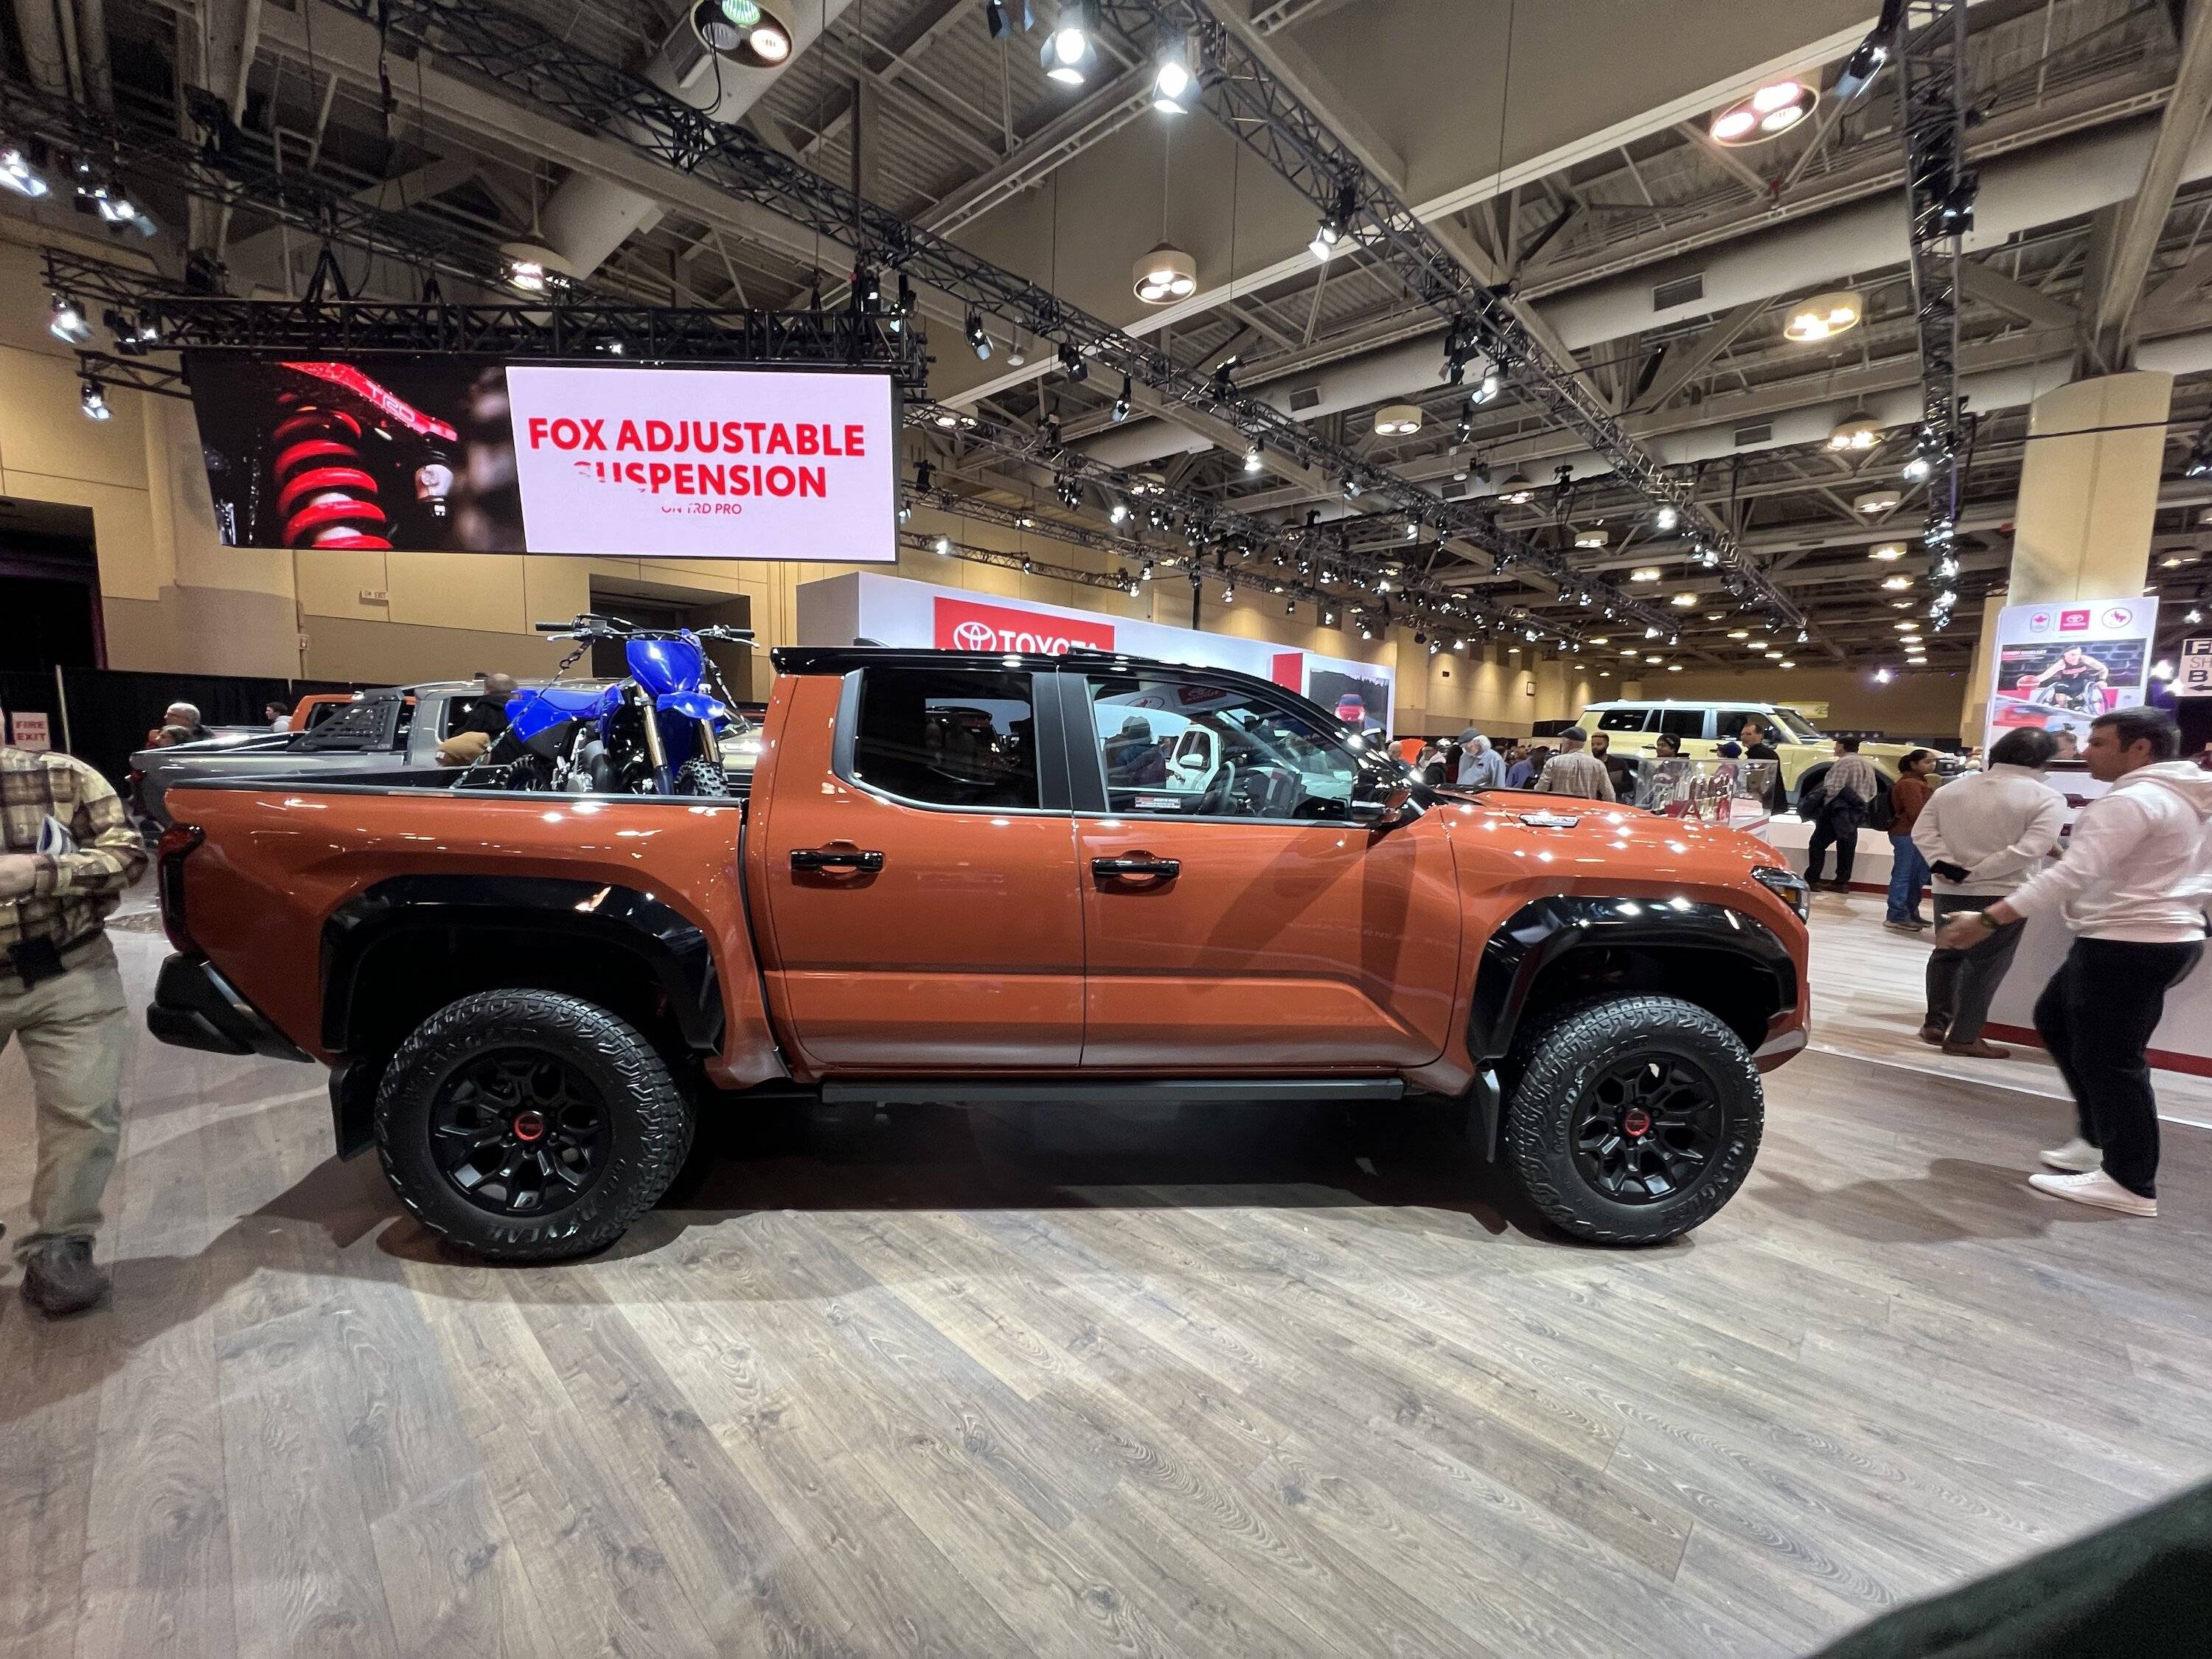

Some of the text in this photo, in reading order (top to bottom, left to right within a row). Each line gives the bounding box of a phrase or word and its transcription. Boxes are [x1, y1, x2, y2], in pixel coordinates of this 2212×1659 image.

[366, 379, 416, 422] TRD
[528, 417, 866, 456] FOX ADJUSTABLE
[714, 504, 742, 515] PRO
[15, 720, 45, 729] FIRE
[17, 732, 46, 741] EXIT
